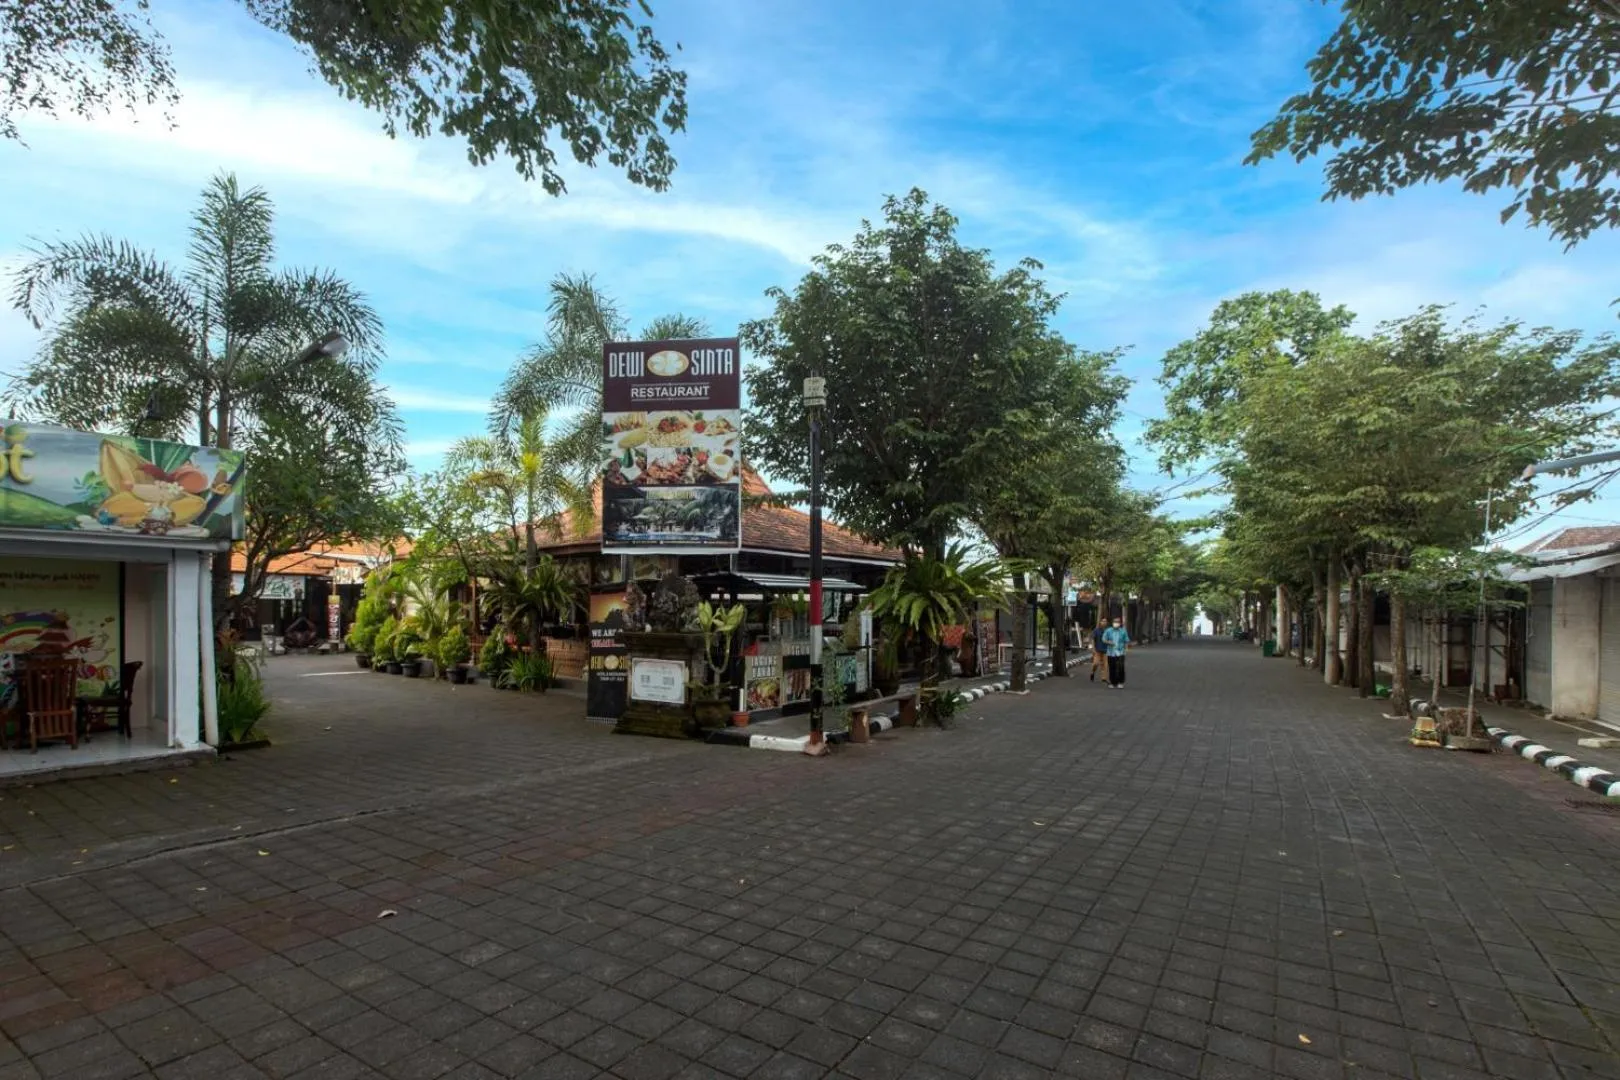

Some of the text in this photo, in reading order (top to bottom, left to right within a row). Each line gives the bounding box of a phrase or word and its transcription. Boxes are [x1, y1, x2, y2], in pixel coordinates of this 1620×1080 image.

[609, 348, 733, 378] DEWI SINTA
[631, 385, 710, 398] RESTAURANT
